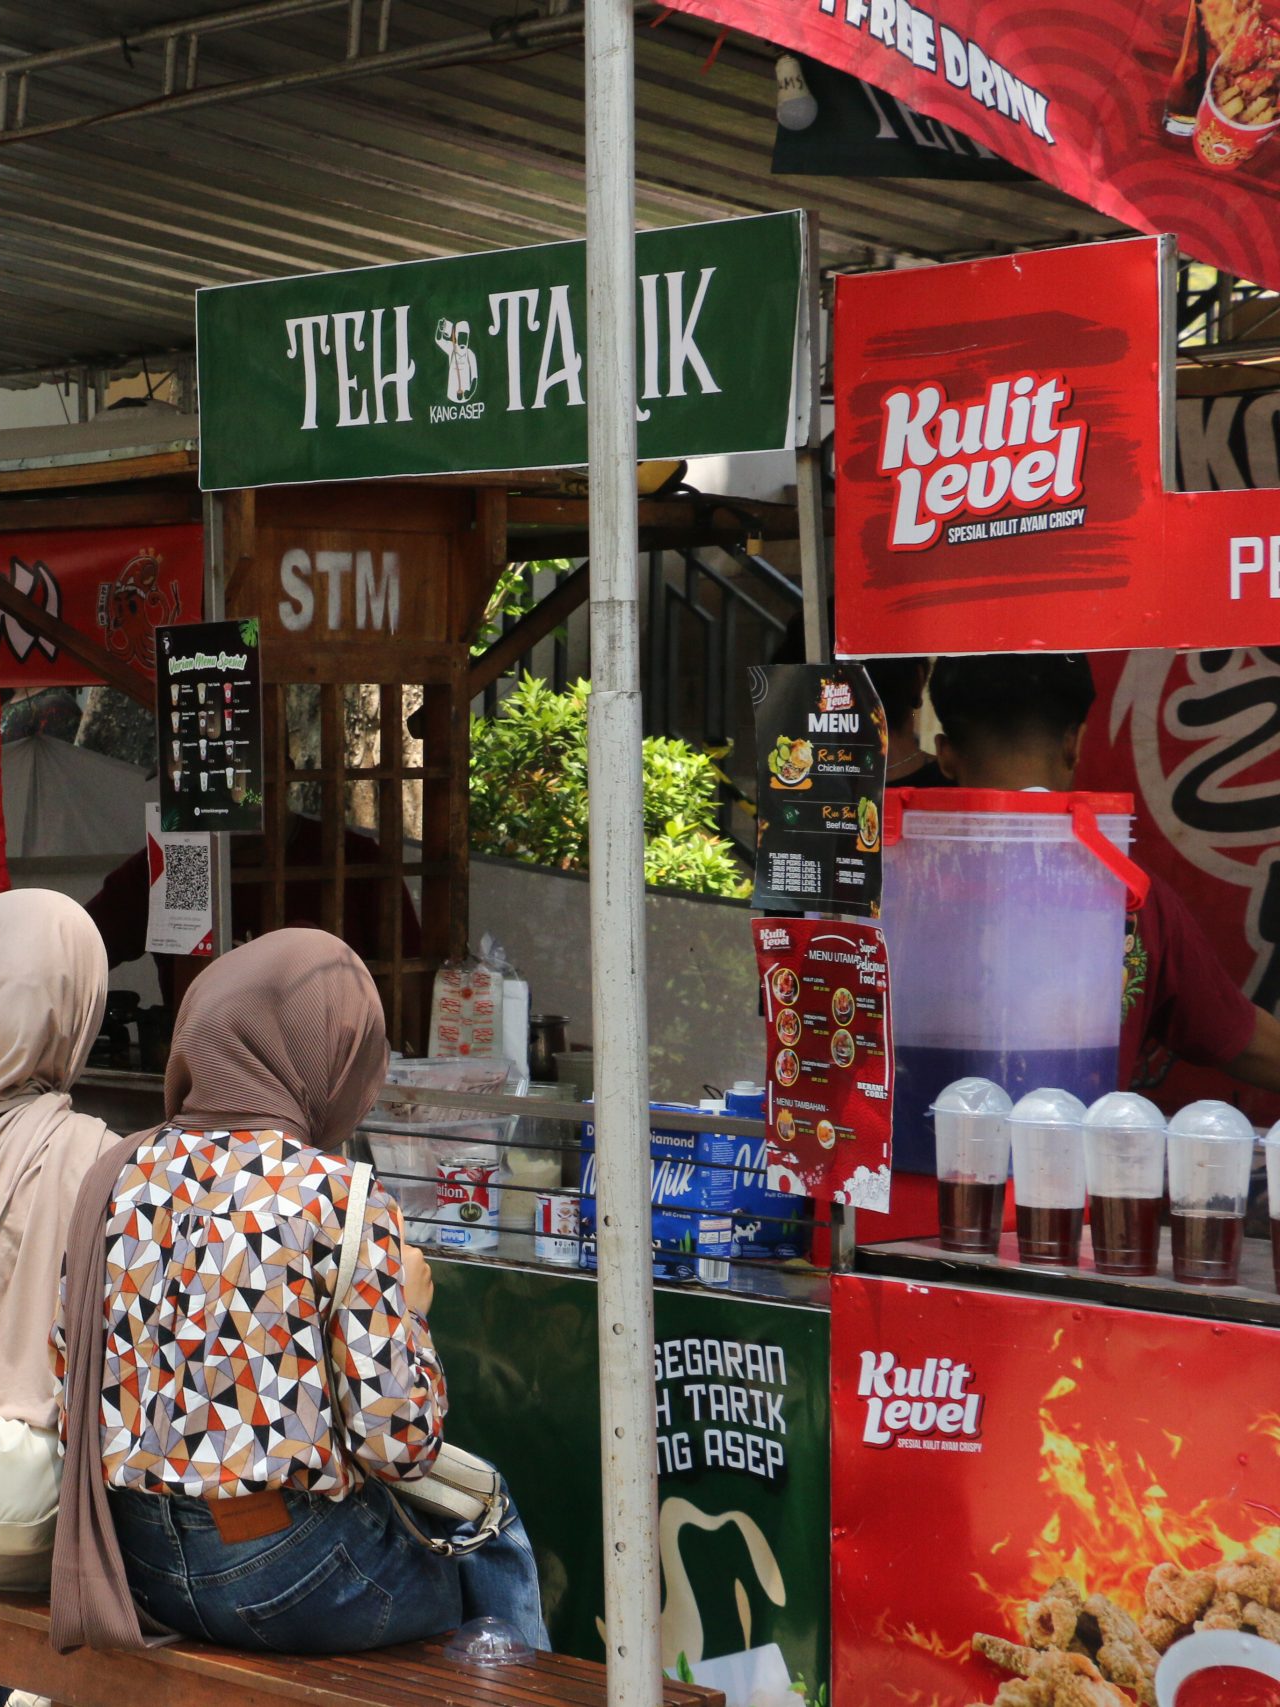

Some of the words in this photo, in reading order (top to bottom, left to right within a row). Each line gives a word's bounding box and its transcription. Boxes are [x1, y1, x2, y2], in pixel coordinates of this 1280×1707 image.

[845, 0, 937, 74] FREE
[939, 25, 1056, 145] DRINK
[286, 305, 415, 430] TEH
[488, 267, 722, 421] TAIK
[430, 405, 457, 424] KANG
[459, 402, 485, 420] ASEP
[882, 376, 1067, 470] Kulit
[892, 425, 1081, 546] Level
[948, 523, 988, 543] SPESIAL
[990, 519, 1018, 538] KULIT
[1020, 514, 1047, 533] AYAM
[1049, 508, 1085, 529] CRISPY
[279, 549, 401, 635] STM
[808, 713, 859, 733] MENU
[818, 764, 844, 773] Chicken
[826, 821, 841, 829] Beef
[760, 929, 786, 940] Kulit
[763, 936, 789, 950] Level
[809, 950, 833, 961] MENU
[860, 971, 875, 985] Food
[776, 1098, 794, 1107] MENU
[795, 1100, 826, 1112] TAMBAHAN
[649, 1131, 695, 1148] iamond
[858, 1351, 970, 1400] Kulit
[684, 1384, 786, 1435] TARIK
[863, 1394, 980, 1445] Level
[704, 1429, 784, 1479] ASEP
[898, 1438, 922, 1449] SPESIAL
